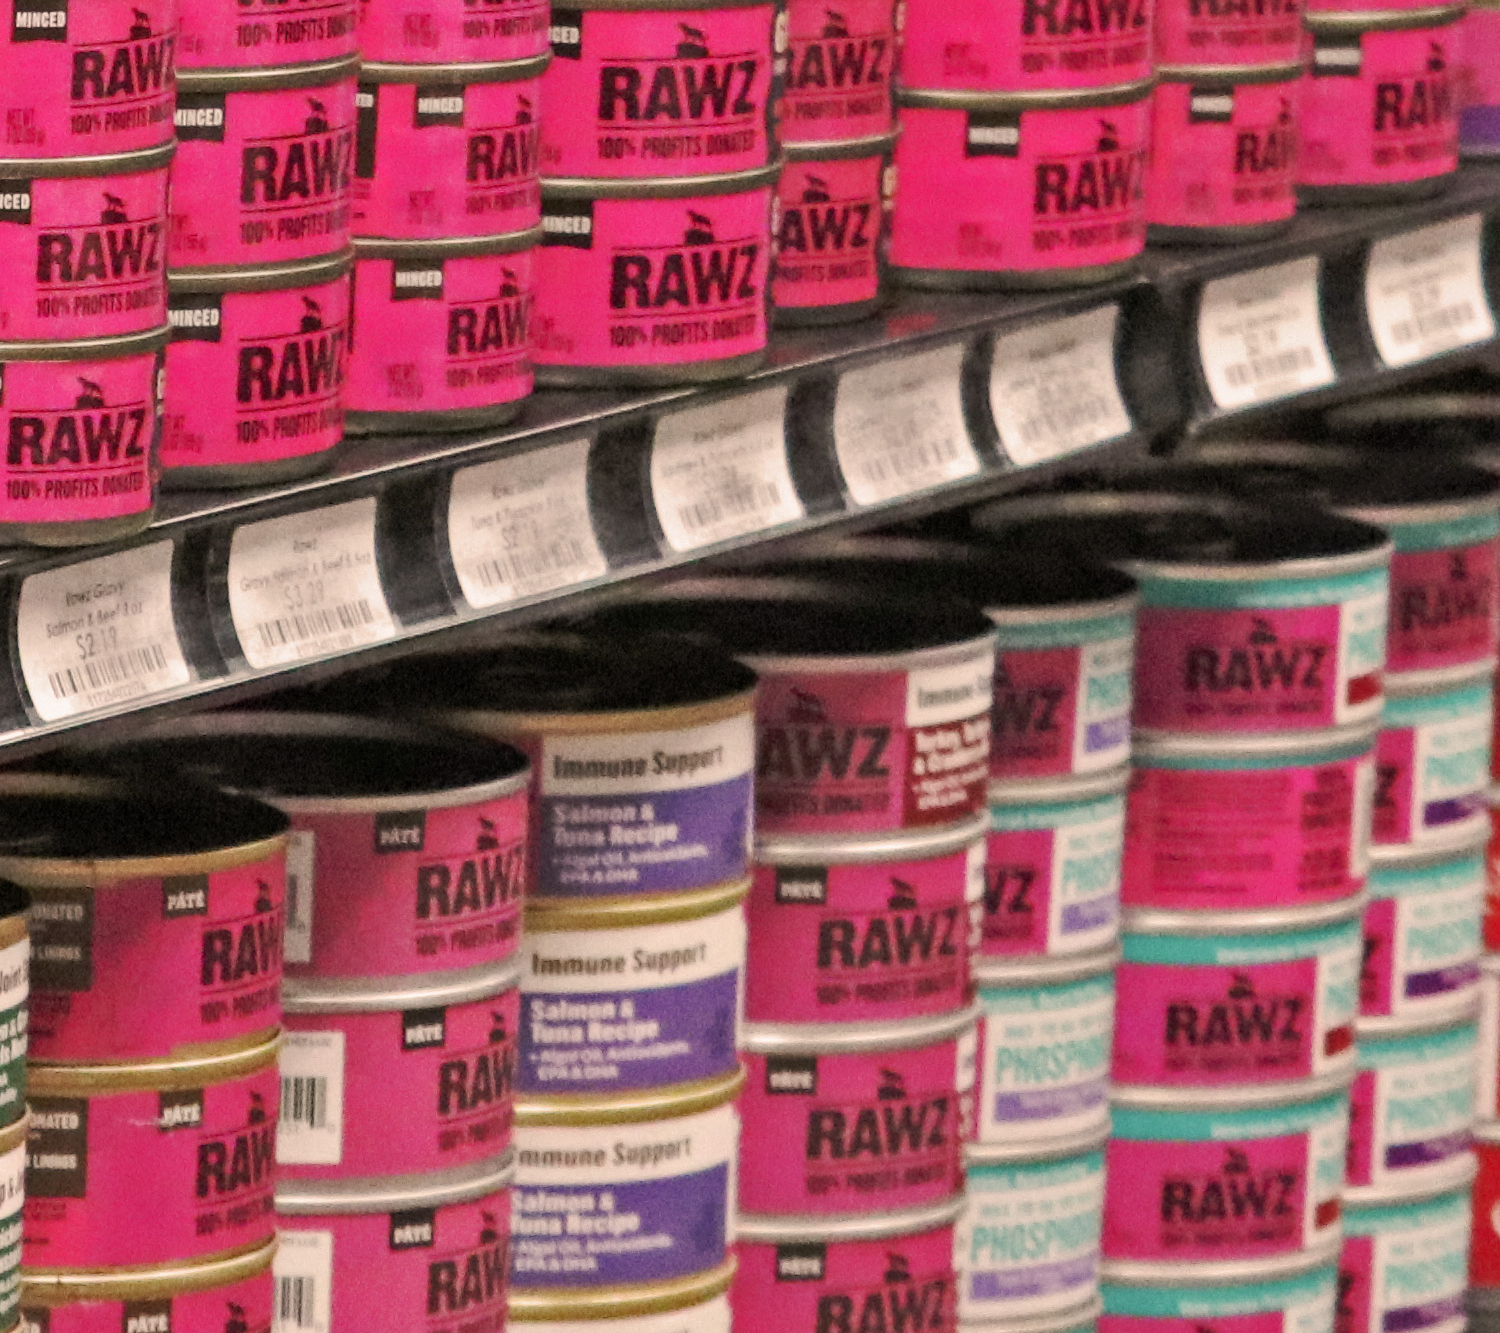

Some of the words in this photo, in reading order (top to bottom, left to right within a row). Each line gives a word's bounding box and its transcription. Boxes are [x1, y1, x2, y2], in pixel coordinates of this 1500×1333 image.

[1184, 644, 1327, 692] RAWZ
[552, 749, 648, 781] Immune
[651, 743, 724, 778] Support
[816, 907, 959, 972] RAWZ
